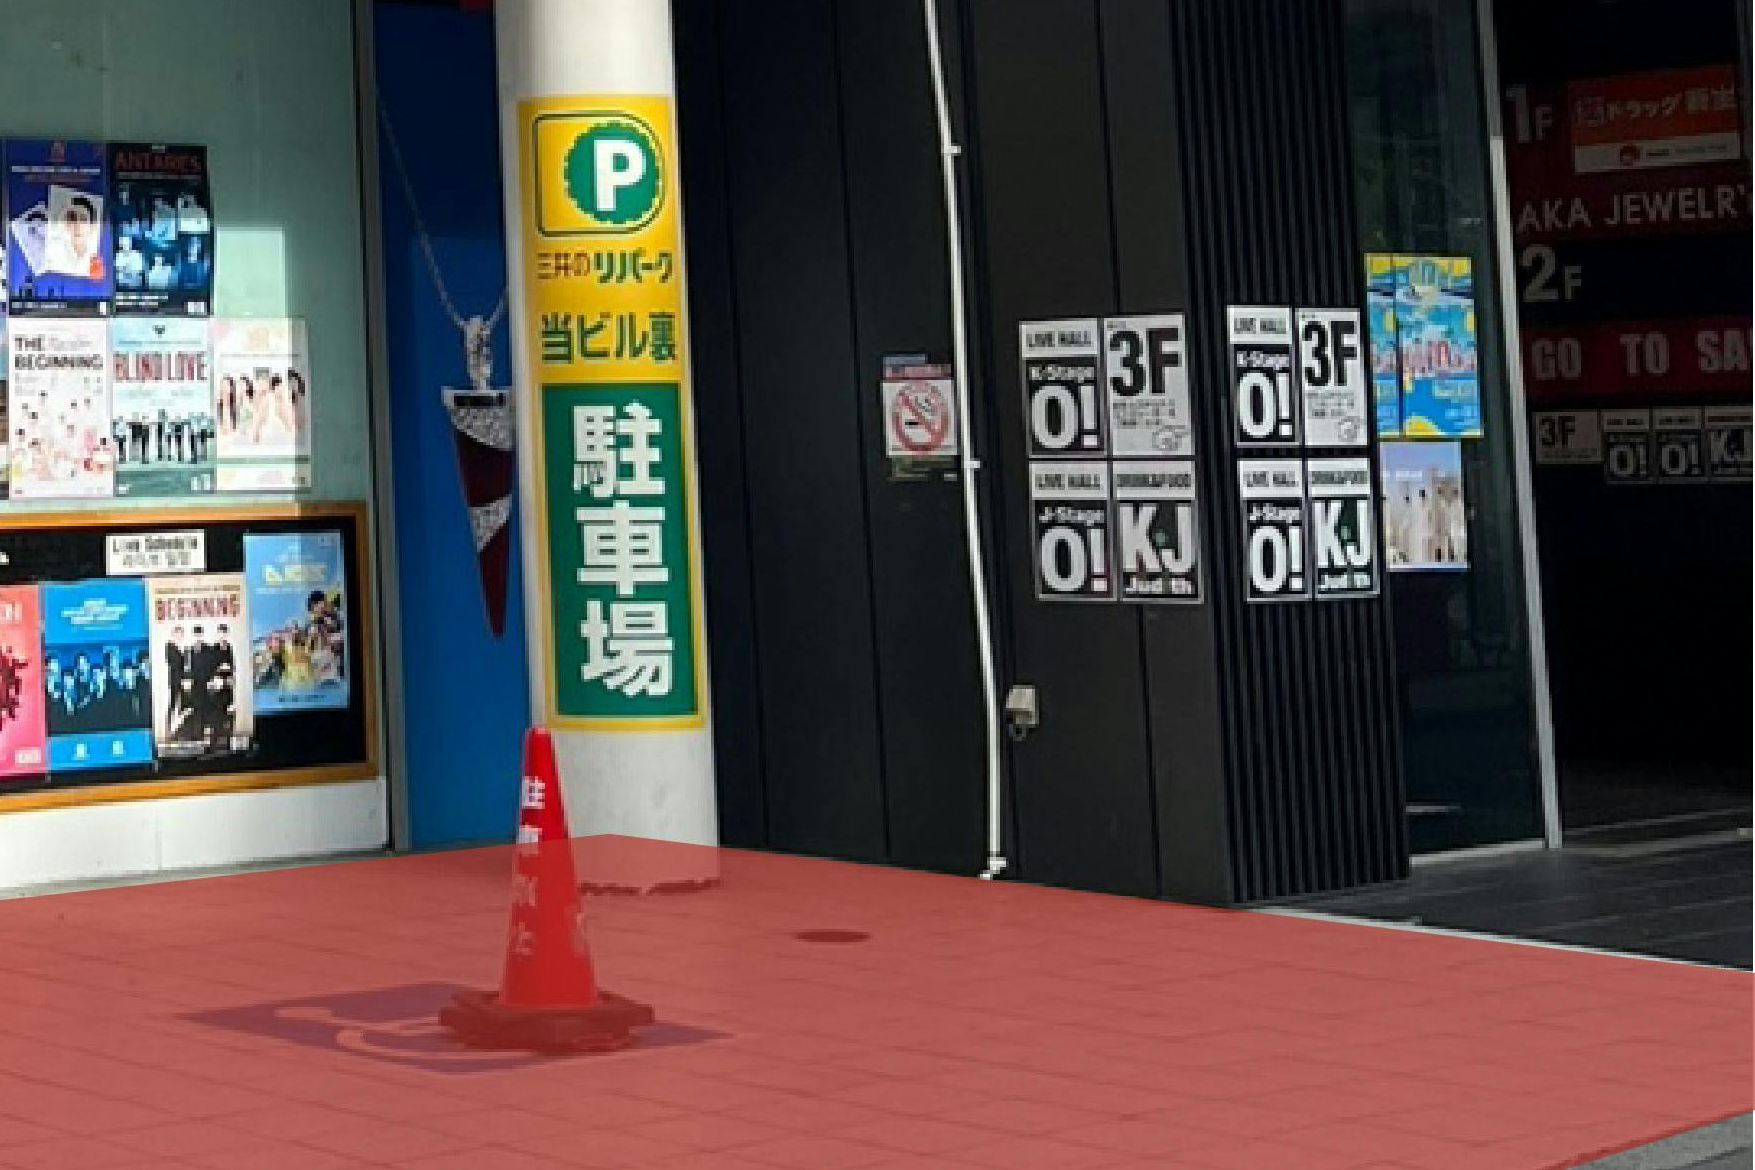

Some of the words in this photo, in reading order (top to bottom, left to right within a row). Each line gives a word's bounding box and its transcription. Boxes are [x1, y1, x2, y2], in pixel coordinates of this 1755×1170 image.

[1505, 83, 1553, 144] 1F
[593, 139, 647, 212] P
[1521, 243, 1583, 303] 2F
[13, 336, 45, 351] THE
[13, 353, 104, 371] BEGINNING
[113, 351, 163, 383] BLIND
[167, 351, 207, 382] LOVE
[541, 311, 676, 364] 当ビル裏
[1026, 331, 1056, 348] LIVE
[1109, 327, 1183, 397] 3F
[1301, 320, 1358, 387] 3F
[1530, 337, 1583, 381] GO
[1619, 332, 1670, 376] TO
[1695, 329, 1750, 375] SA
[1031, 385, 1099, 449] O!
[1237, 371, 1292, 438] O!
[1539, 415, 1577, 449] 3F
[1035, 473, 1066, 491] LIVE
[572, 398, 675, 698] 駐車場
[1040, 526, 1109, 592] O!
[1249, 525, 1304, 592] O!
[153, 592, 241, 625] BEGINNING
